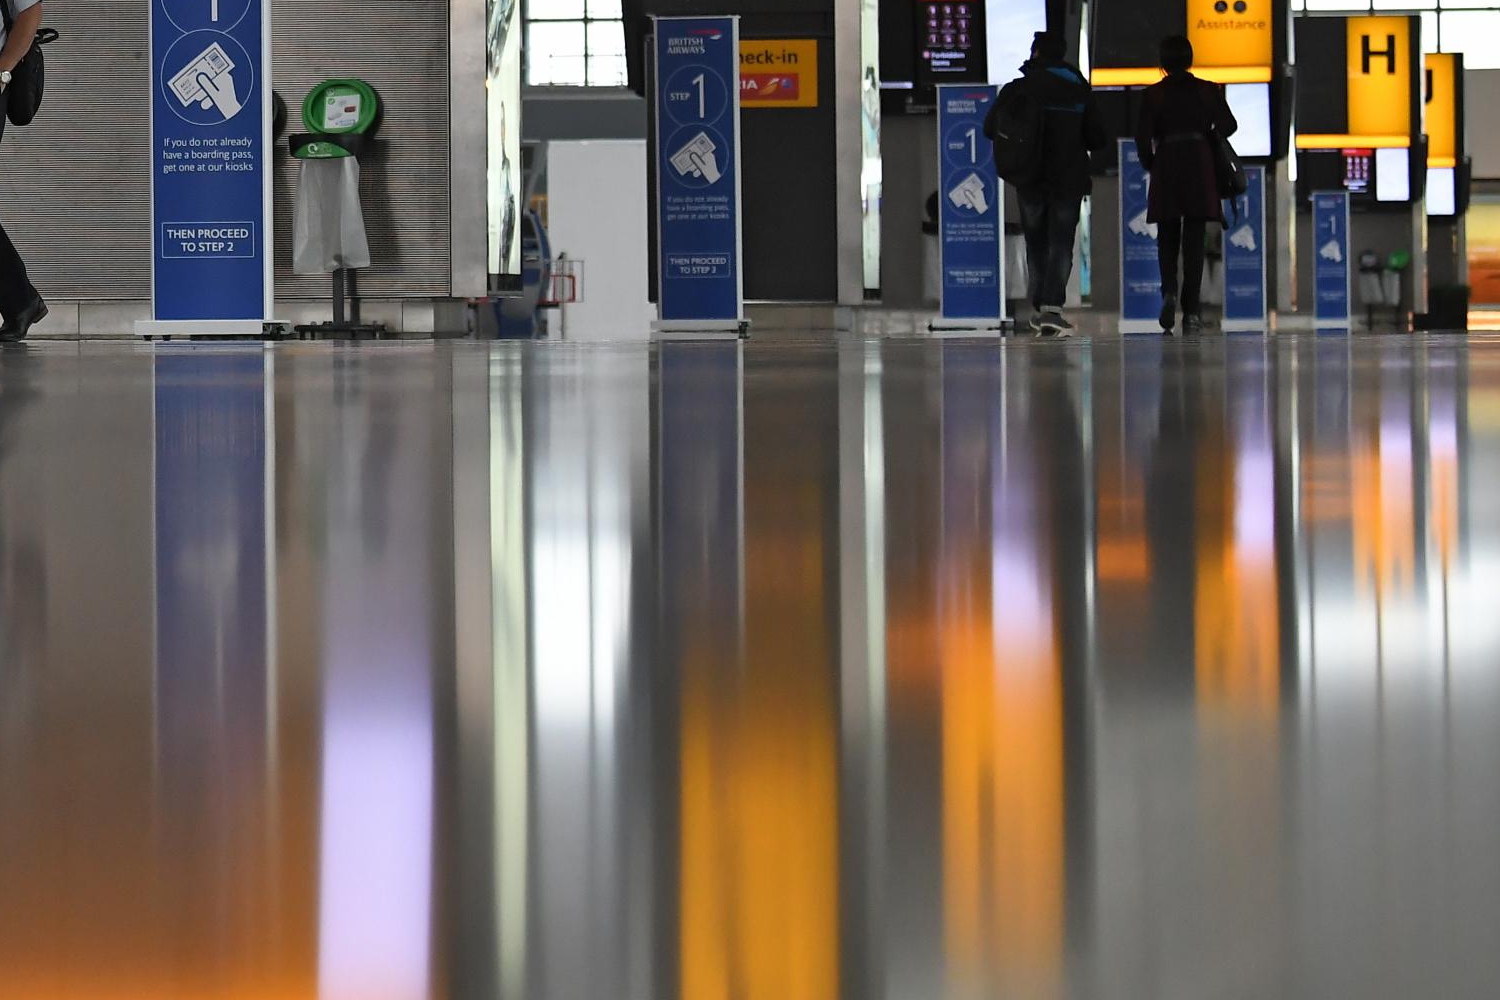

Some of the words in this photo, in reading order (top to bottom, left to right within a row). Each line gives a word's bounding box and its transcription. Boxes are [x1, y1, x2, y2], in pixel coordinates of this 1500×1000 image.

[668, 38, 703, 46] BRITISH
[667, 46, 705, 54] AIRWAYS
[1361, 34, 1396, 75] H
[739, 49, 798, 65] eck-in
[670, 92, 691, 101] STEP
[692, 73, 705, 119] 1
[164, 138, 170, 147] If
[171, 139, 187, 148] you
[189, 138, 201, 147] do
[203, 138, 218, 147] not
[219, 137, 252, 148] already
[965, 128, 976, 163] 1
[163, 150, 183, 160] have
[184, 152, 189, 160] a
[191, 150, 230, 161] boarding
[232, 151, 254, 161] pass,
[163, 164, 177, 174] get
[178, 164, 195, 172] one
[197, 163, 206, 171] at
[208, 163, 223, 171] our
[225, 161, 253, 171] kiosks
[167, 229, 196, 239] THEN
[198, 228, 249, 239] PROCEED
[181, 242, 196, 252] TO
[198, 242, 225, 252] STEP
[227, 242, 234, 251] 2
[691, 257, 727, 265] PROCEED
[680, 266, 691, 274] TO
[691, 266, 710, 274] STEP
